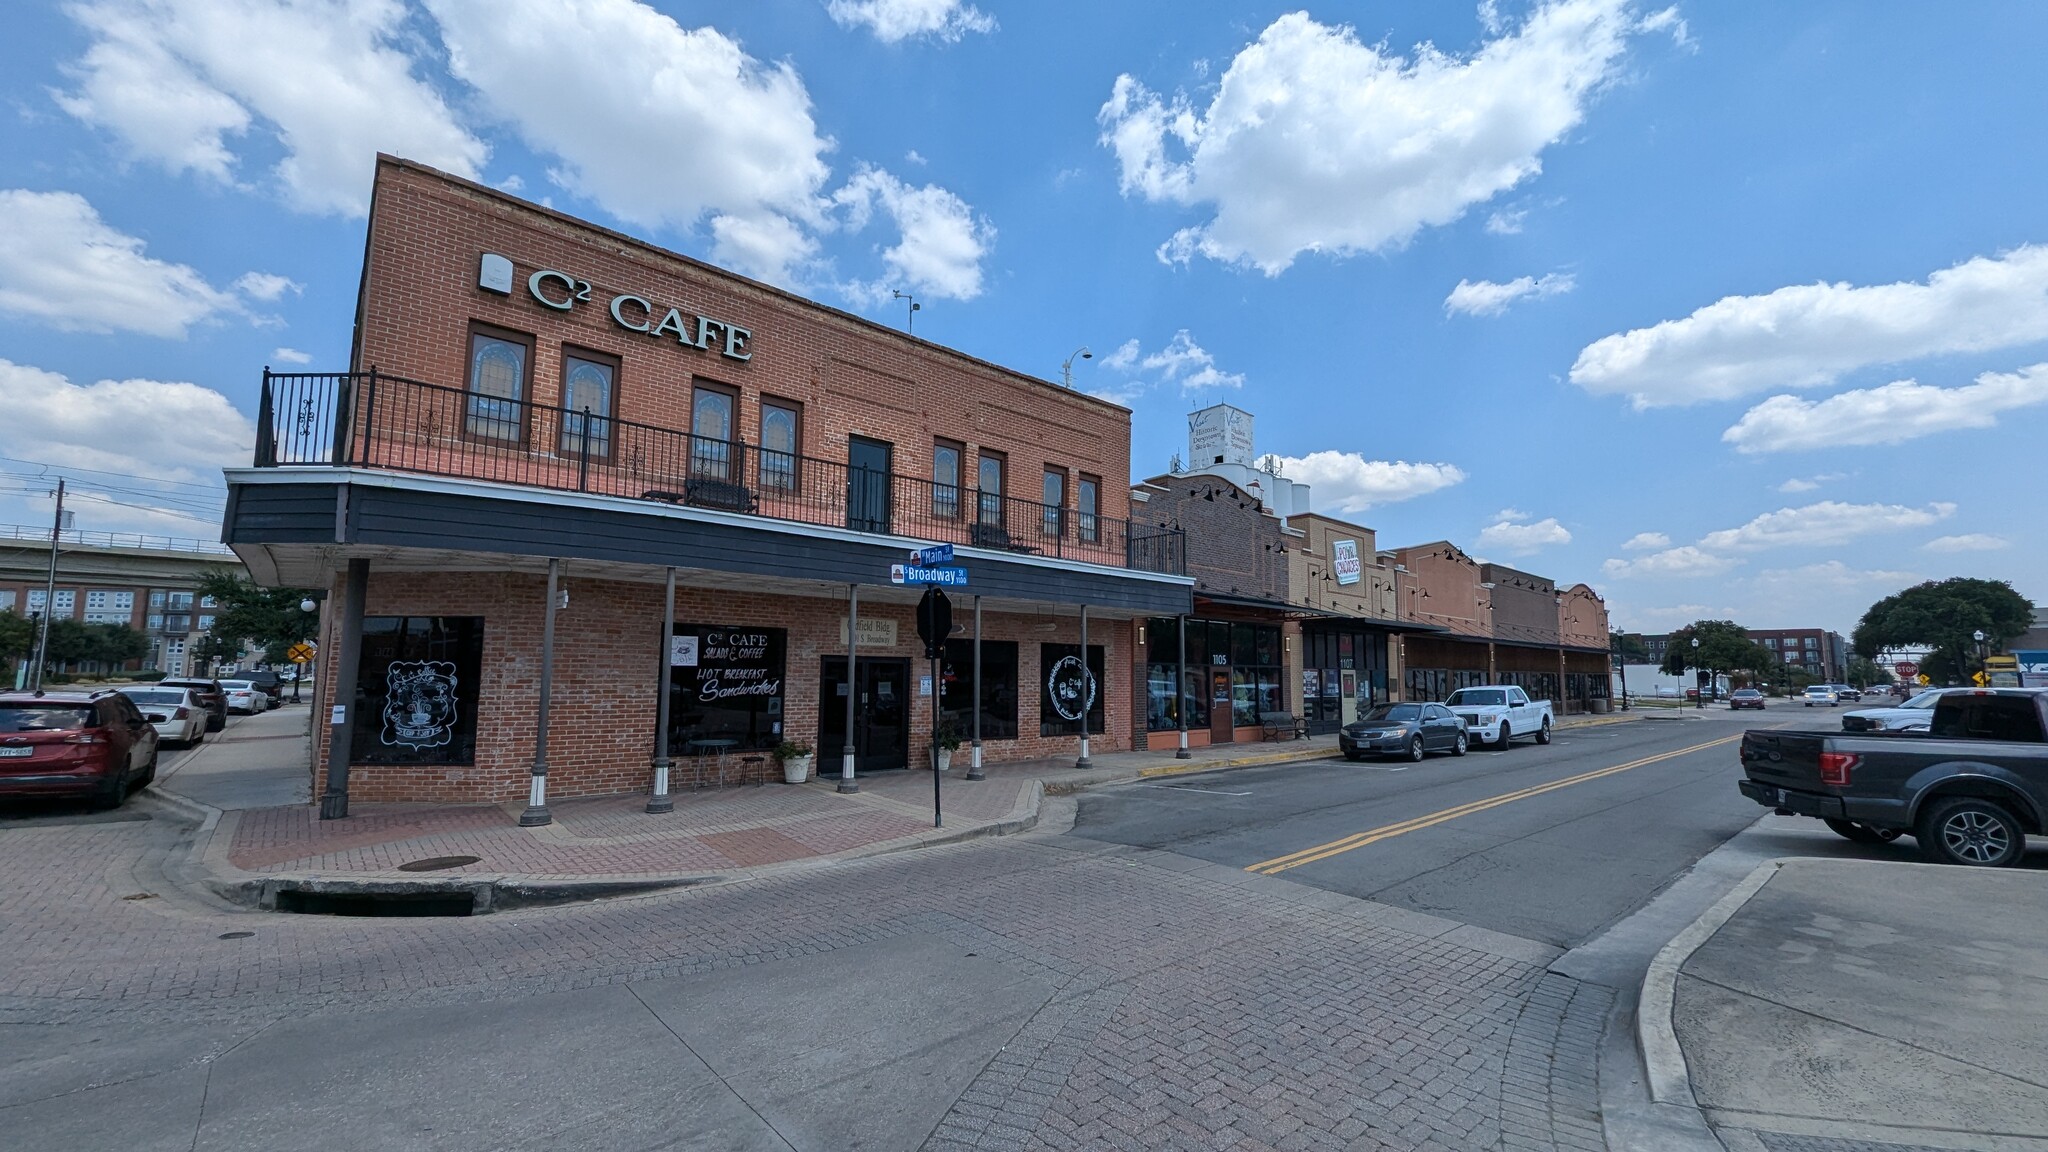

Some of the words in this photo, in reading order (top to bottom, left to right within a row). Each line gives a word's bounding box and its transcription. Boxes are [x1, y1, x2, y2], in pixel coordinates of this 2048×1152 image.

[610, 294, 752, 361] CAFE
[925, 548, 943, 564] Main
[904, 566, 908, 574] S
[908, 567, 956, 585] Broadway
[958, 569, 964, 577] St
[729, 634, 768, 647] CAFE
[703, 647, 729, 659] SALADS
[729, 646, 738, 662] &
[738, 647, 765, 659] COFFEE
[1212, 654, 1227, 665] 1105
[1340, 658, 1353, 669] 1107
[1896, 664, 1917, 674] STOP
[696, 668, 722, 680] HOT
[723, 668, 768, 680] BREAKFAST
[698, 678, 780, 702] Sandwiches
